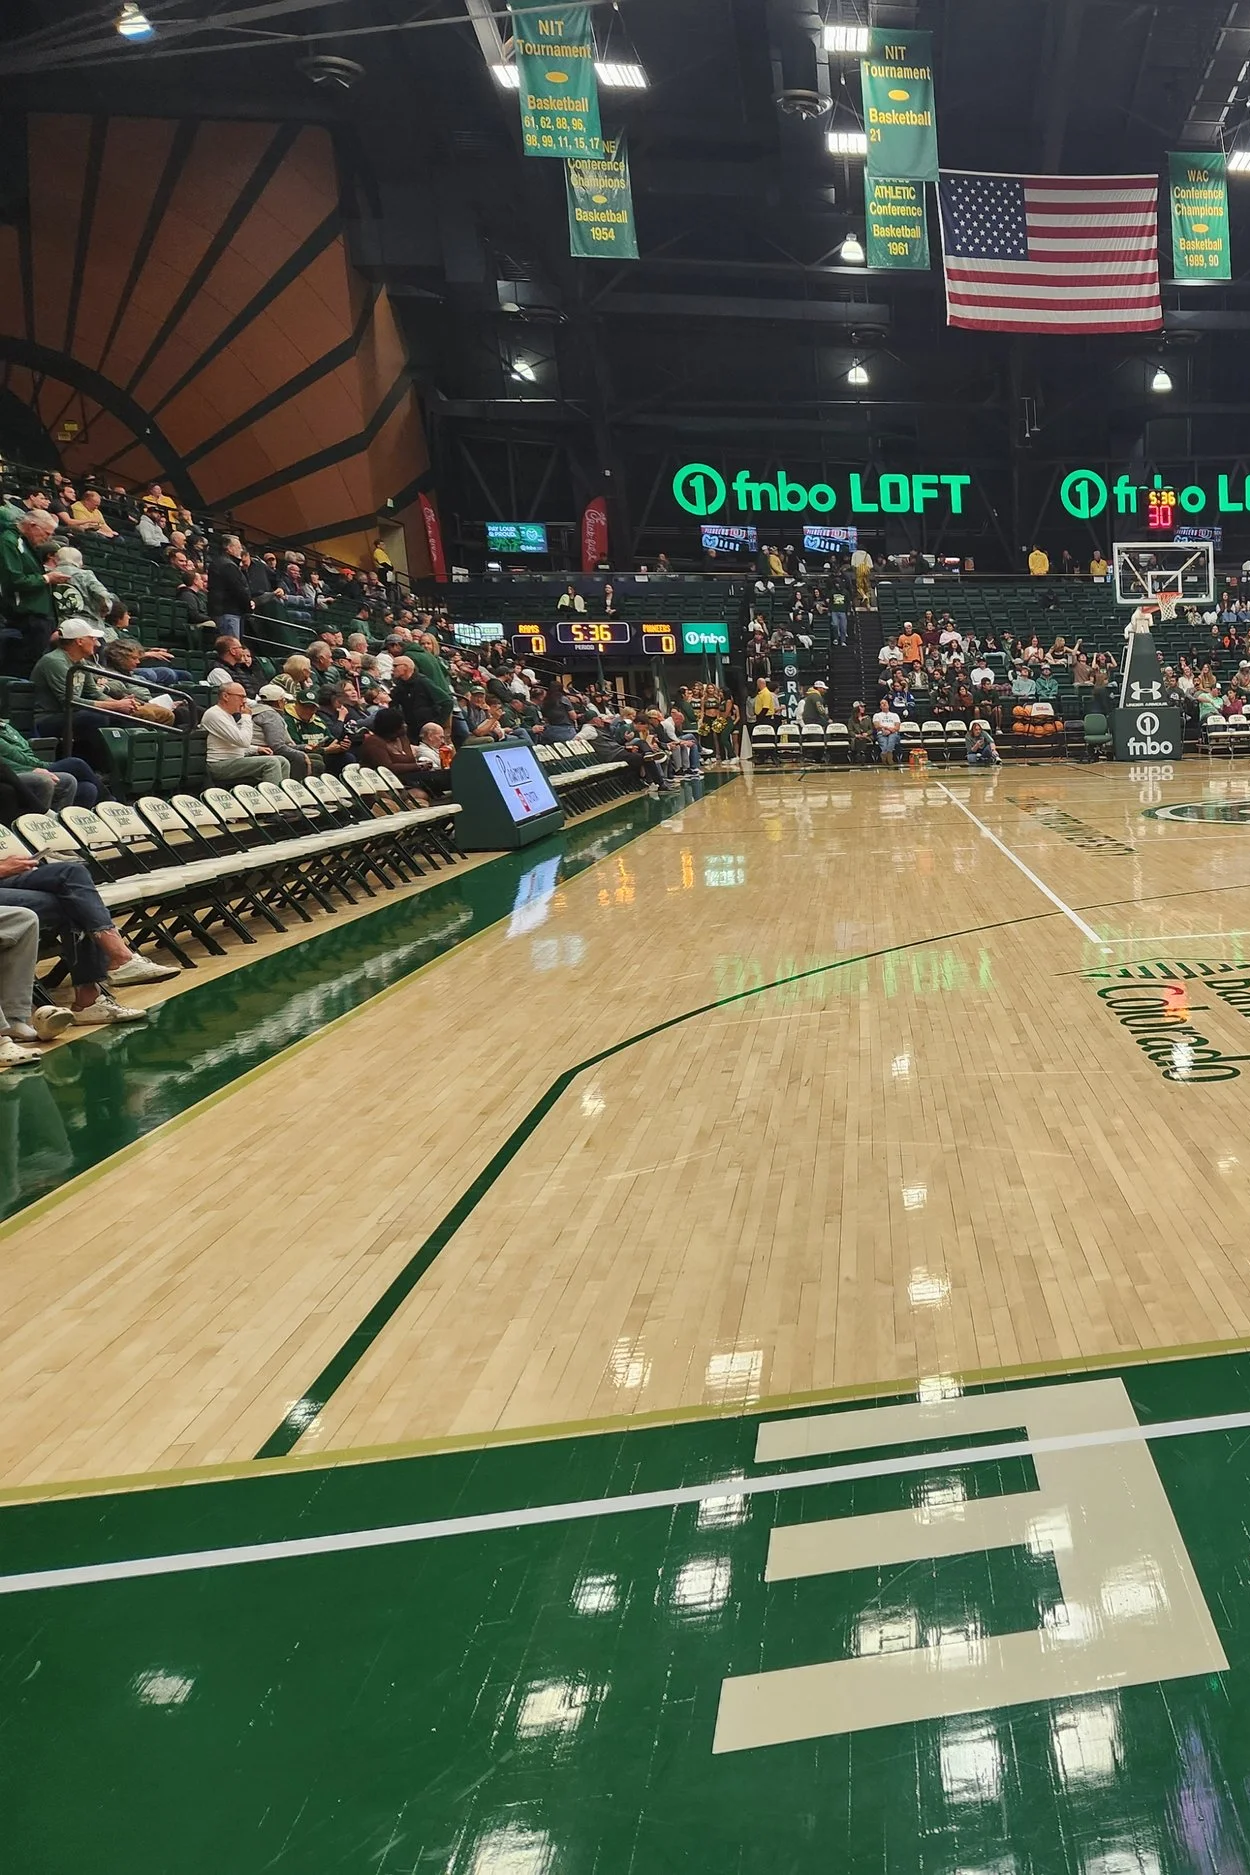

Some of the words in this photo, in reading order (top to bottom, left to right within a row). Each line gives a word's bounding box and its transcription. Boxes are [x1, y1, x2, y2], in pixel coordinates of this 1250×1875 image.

[538, 19, 564, 37] NIT
[516, 39, 592, 59] Tournament
[884, 45, 907, 61] NIT
[863, 61, 931, 80] Tournament
[527, 95, 589, 113] Basketball
[540, 116, 554, 131] 62,
[868, 107, 932, 127] Basketball
[870, 128, 881, 142] 21
[558, 136, 572, 151] 11,
[573, 136, 588, 151] 15,
[589, 137, 600, 149] 17
[567, 157, 625, 172] Conference
[570, 173, 626, 190] Champions
[1187, 169, 1210, 183] WAC
[874, 185, 916, 200] ATHLETIC
[1173, 186, 1224, 200] Conference
[575, 207, 628, 224] Basketball
[869, 201, 923, 217] Conference
[1174, 203, 1224, 219] Champions
[590, 226, 616, 241] 1954
[872, 223, 922, 239] Basketball
[887, 241, 910, 256] 1961
[1179, 237, 1223, 252] Basketball
[1208, 254, 1219, 267] 90
[732, 470, 837, 512] fnbo
[849, 473, 971, 514] LOFT
[1148, 490, 1177, 506] 5:36
[1148, 504, 1173, 528] 30
[518, 624, 540, 634] RAMS
[570, 624, 613, 642] 5:36
[531, 636, 543, 653] 0
[661, 636, 673, 653] 0
[1126, 736, 1174, 756] fnbo
